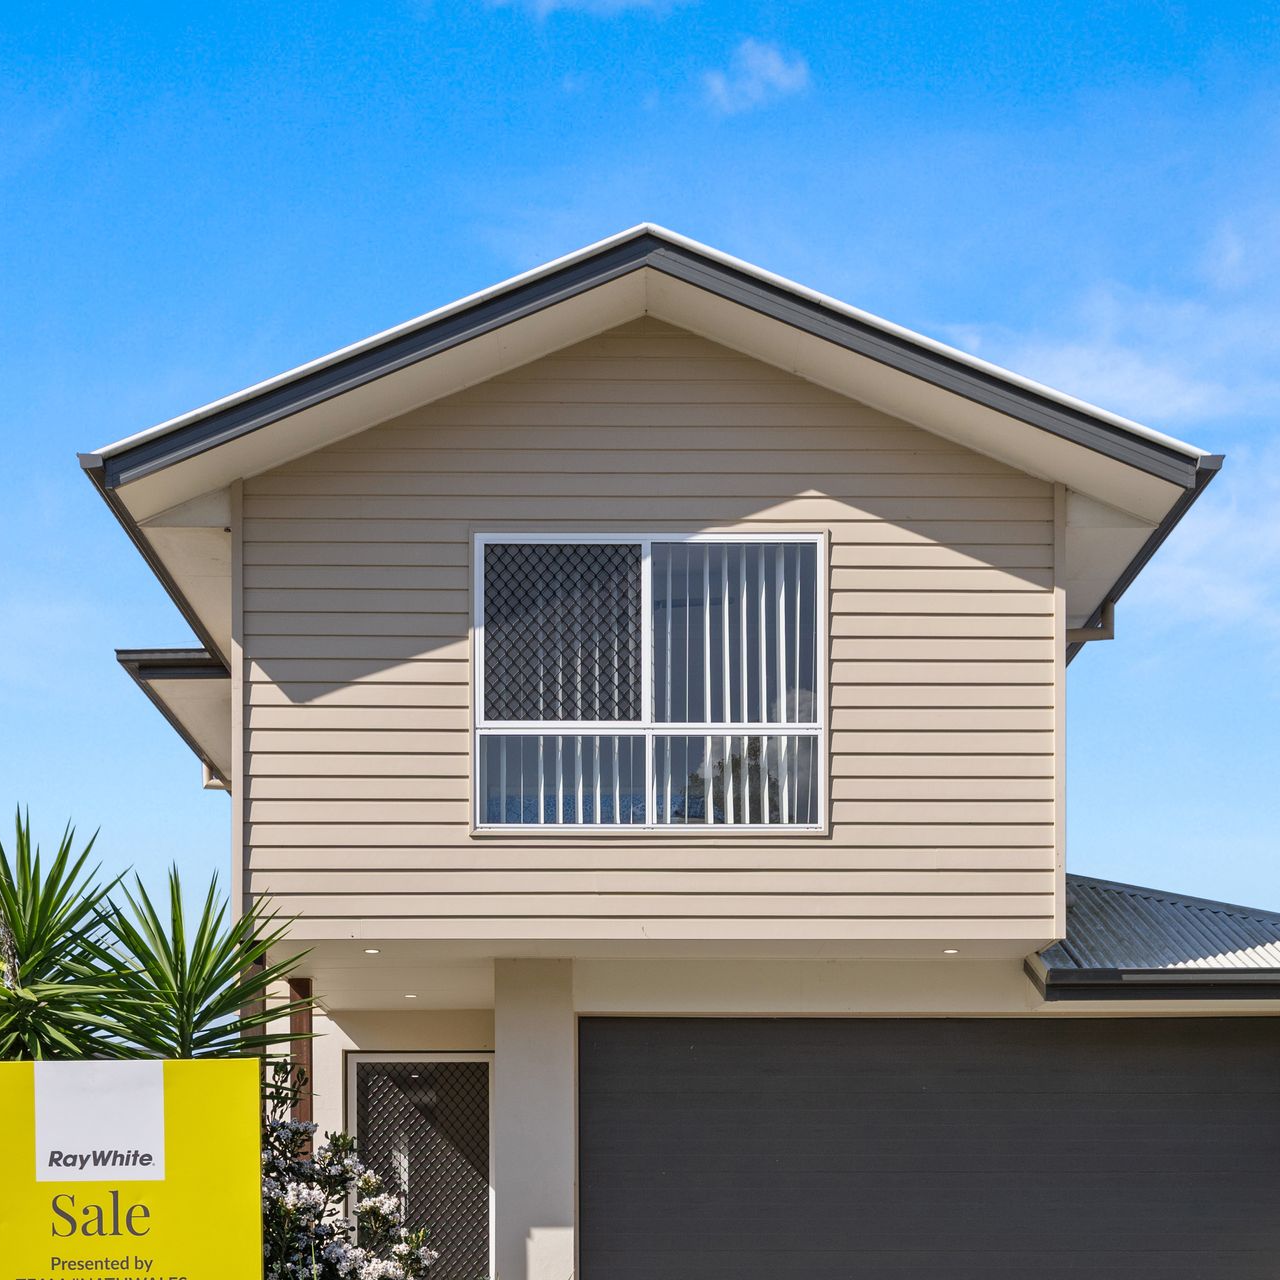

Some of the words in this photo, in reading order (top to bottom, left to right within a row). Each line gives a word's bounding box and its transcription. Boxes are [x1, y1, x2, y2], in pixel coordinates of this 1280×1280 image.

[51, 1189, 151, 1238] Sale
[51, 1255, 130, 1271] Presented
[134, 1255, 154, 1273] by
